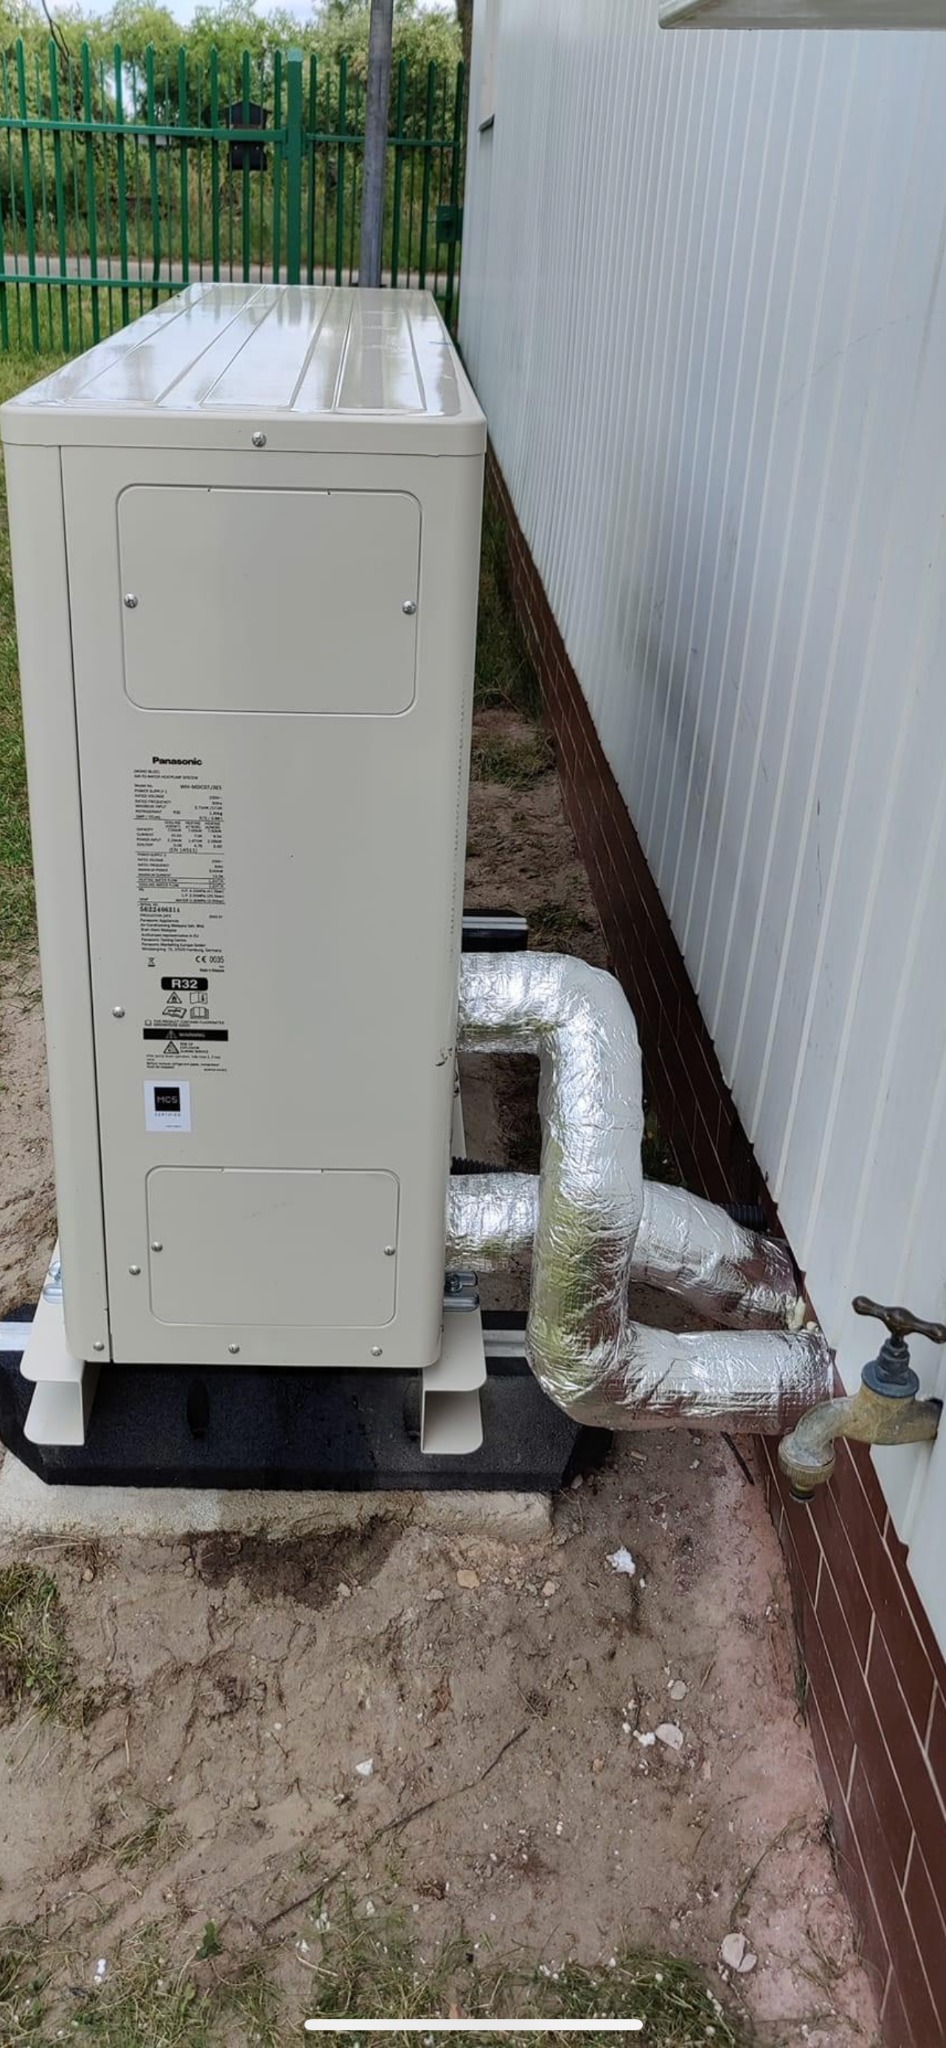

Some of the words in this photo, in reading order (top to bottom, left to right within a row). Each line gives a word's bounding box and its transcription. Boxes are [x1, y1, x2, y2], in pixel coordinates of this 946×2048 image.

[152, 756, 202, 766] Panasonic
[171, 978, 198, 989] R32
[156, 1095, 178, 1104] MCS
